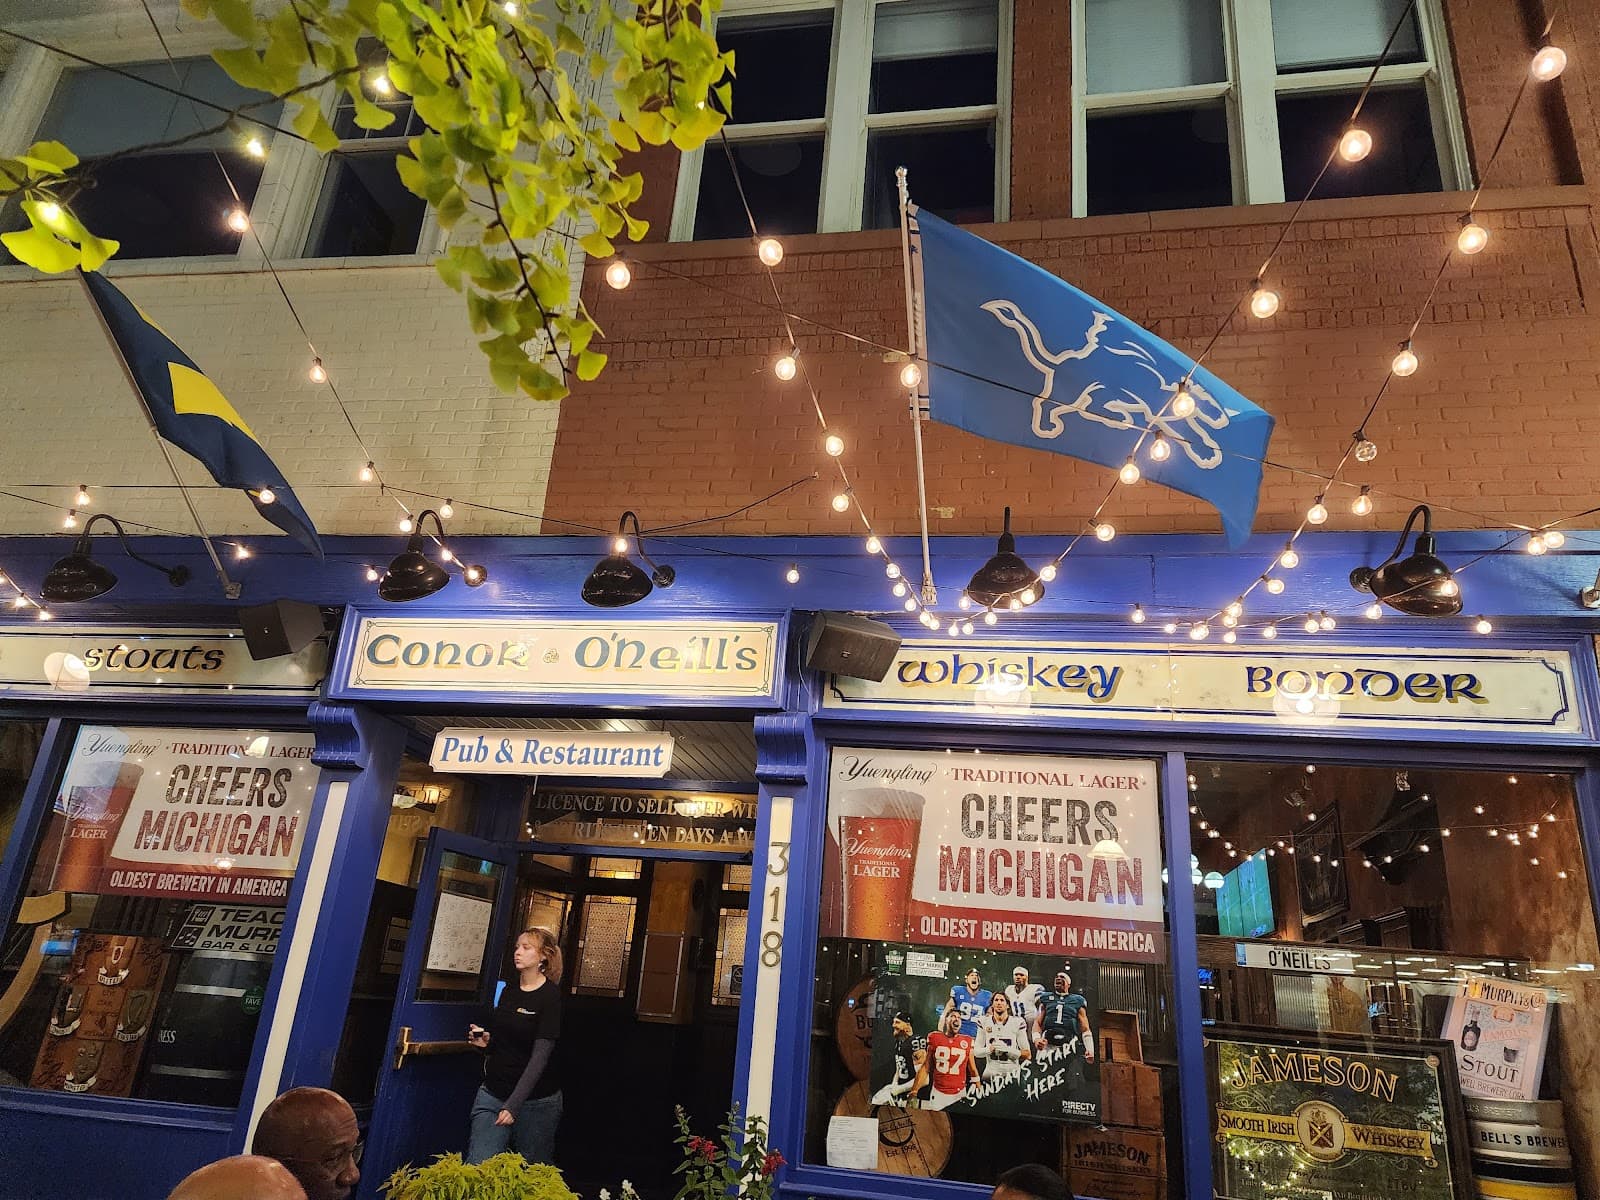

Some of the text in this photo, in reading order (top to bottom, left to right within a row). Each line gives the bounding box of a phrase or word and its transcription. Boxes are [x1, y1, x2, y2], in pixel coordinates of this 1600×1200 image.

[84, 645, 225, 671] stouts
[897, 653, 1121, 699] whiskey
[83, 734, 161, 760] Yuengling
[172, 743, 267, 758] TRADITION
[440, 736, 664, 767] Pub & Restaurant
[839, 755, 938, 785] Yuengling
[951, 767, 1140, 791] TRADITIONAL LAGER
[166, 764, 292, 808] CHEERS
[536, 794, 605, 812] LICENCE
[610, 796, 633, 813] TO
[637, 798, 677, 816] SELL
[961, 793, 1119, 846] CHEERS
[70, 828, 108, 839] LAGER
[133, 810, 299, 857] MICHIGAN
[675, 826, 715, 844] DAYS
[845, 838, 913, 859] Yuengling
[110, 871, 288, 897] OLDEST BREWERY IN AMERICA
[853, 865, 901, 878] LAGER
[938, 845, 1144, 906] MICHIGAN
[201, 940, 233, 950] BAR
[238, 942, 250, 951] &
[920, 915, 1156, 953] OLDEST BREWERY IN AMERICA
[1268, 950, 1331, 970] O'NEILLS
[1054, 1005, 1064, 1025] 1
[934, 1046, 967, 1075] 87
[1036, 1035, 1079, 1073] START
[1231, 1052, 1400, 1103] JAMESON
[1460, 1054, 1519, 1083] STOUT
[965, 1061, 1032, 1107] SUNDAYS
[1025, 1068, 1066, 1102] HERE
[1062, 1100, 1096, 1112] DIRECTV
[1220, 1114, 1425, 1151] SMOOTH IRISH WHISKEY
[1480, 1131, 1522, 1146] BELL'S
[1074, 1140, 1152, 1166] JAMESON
